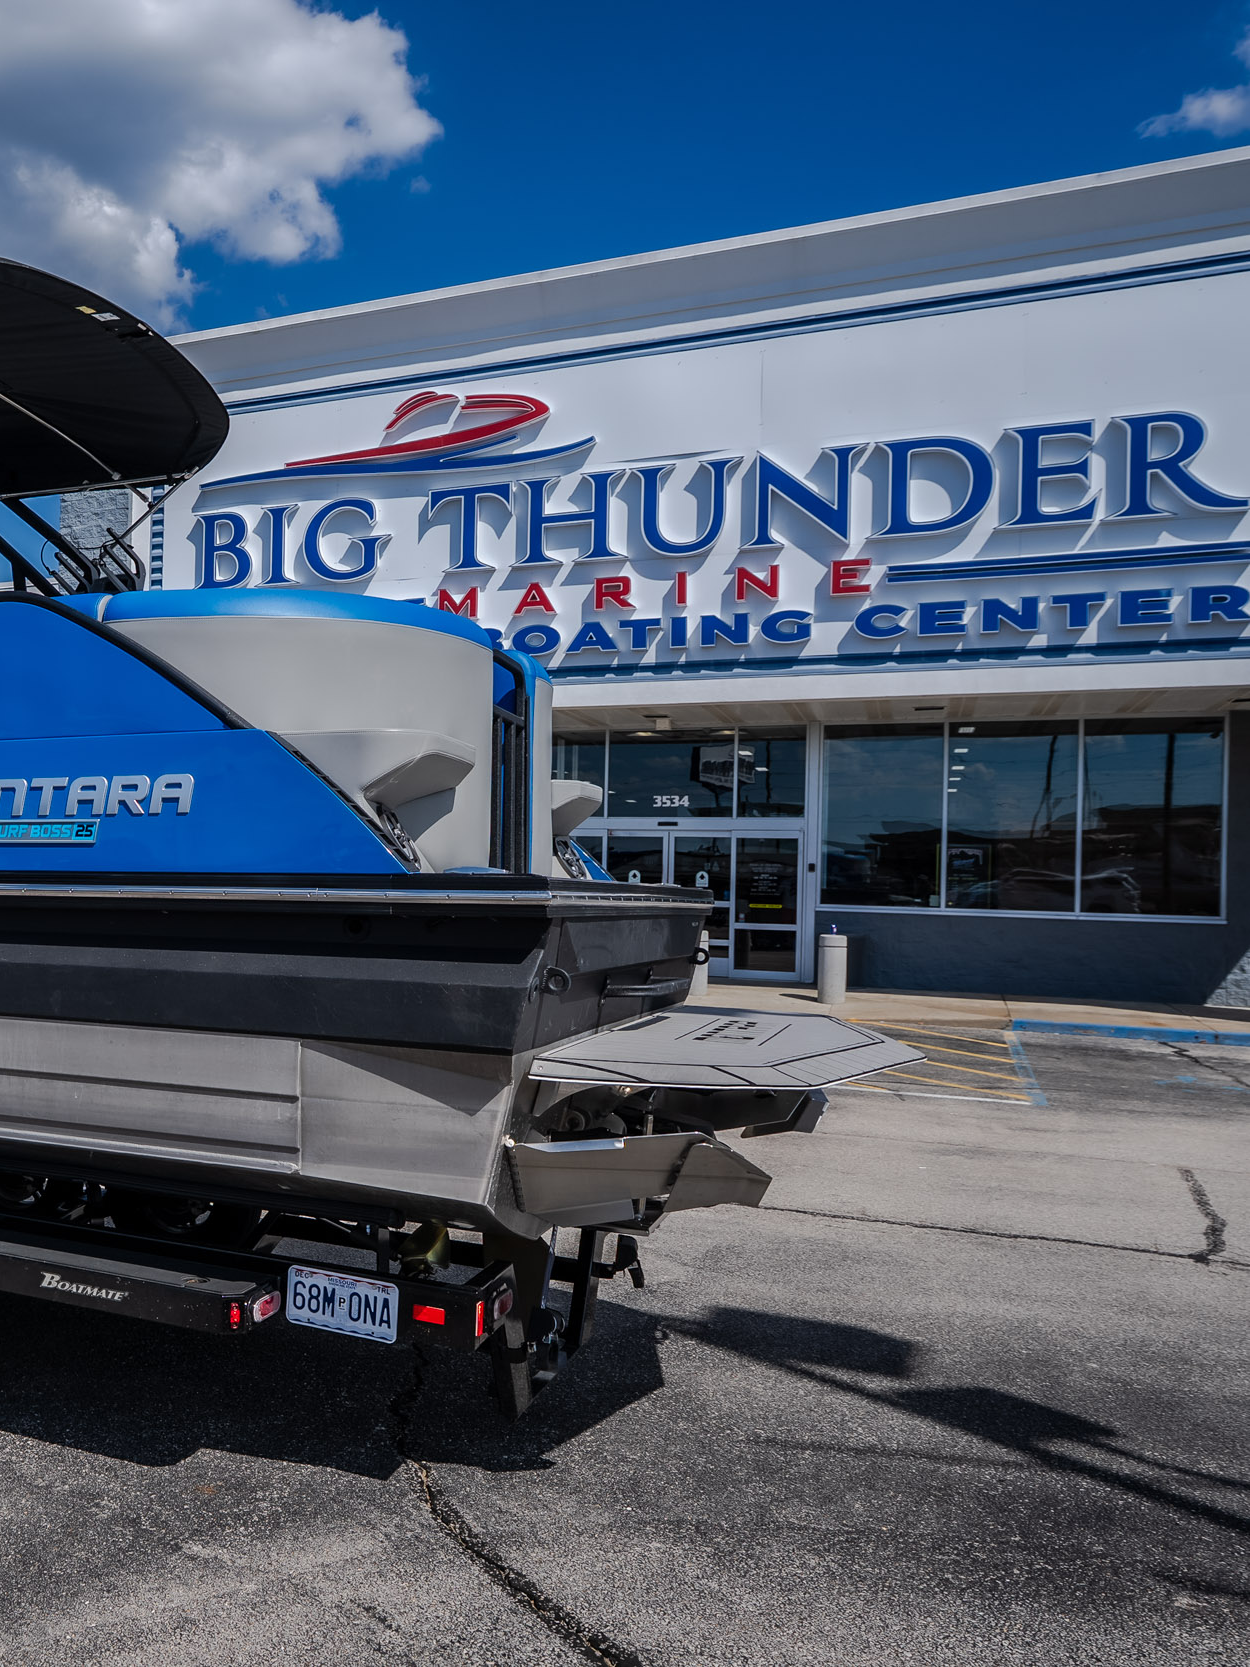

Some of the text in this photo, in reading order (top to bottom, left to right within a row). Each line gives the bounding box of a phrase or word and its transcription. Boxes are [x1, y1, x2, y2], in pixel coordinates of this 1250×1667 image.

[195, 409, 1250, 590] BIG THUNDER
[438, 557, 873, 619] MARINE
[853, 584, 1250, 640] CENTER
[653, 795, 690, 808] 3534
[29, 824, 72, 838] BOSS
[75, 824, 95, 838] 25
[294, 1270, 310, 1279] DEC
[327, 1277, 358, 1288] MISSOURI
[377, 1286, 391, 1296] TRL
[293, 1280, 336, 1318] 68M
